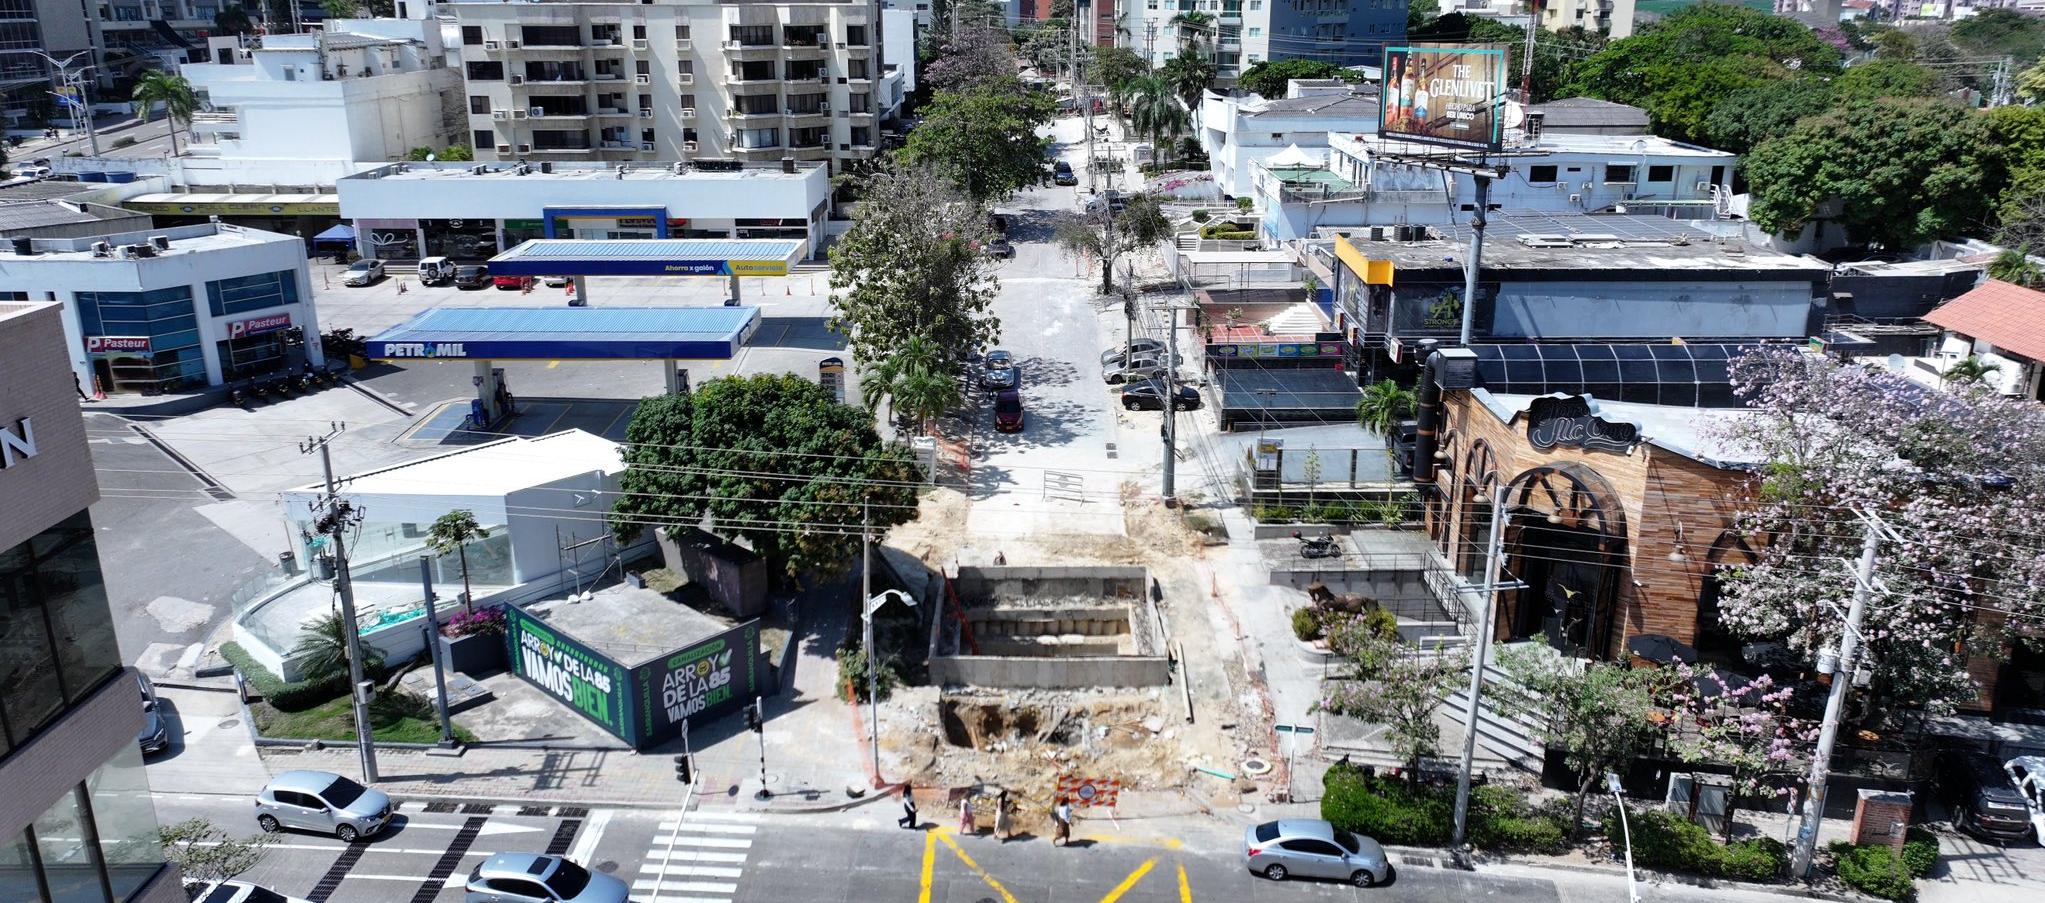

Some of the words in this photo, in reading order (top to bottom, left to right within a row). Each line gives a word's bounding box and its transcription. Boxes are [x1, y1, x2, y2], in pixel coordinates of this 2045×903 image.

[1453, 65, 1471, 78] THE
[1430, 78, 1494, 101] GLENLIVET
[1463, 103, 1476, 111] PARA
[695, 264, 714, 273] galón
[248, 317, 286, 330] Pasteur
[104, 339, 146, 348] Pasteur
[564, 654, 580, 677] DE
[581, 663, 595, 685] LA
[595, 671, 611, 694] 85
[521, 645, 573, 702] VAMOS
[572, 675, 613, 727] BIEN.
[663, 684, 687, 709] DE
[689, 678, 709, 699] LA
[709, 666, 731, 689] 85
[667, 694, 706, 724] VAMOS
[706, 685, 733, 708] BIEN.
